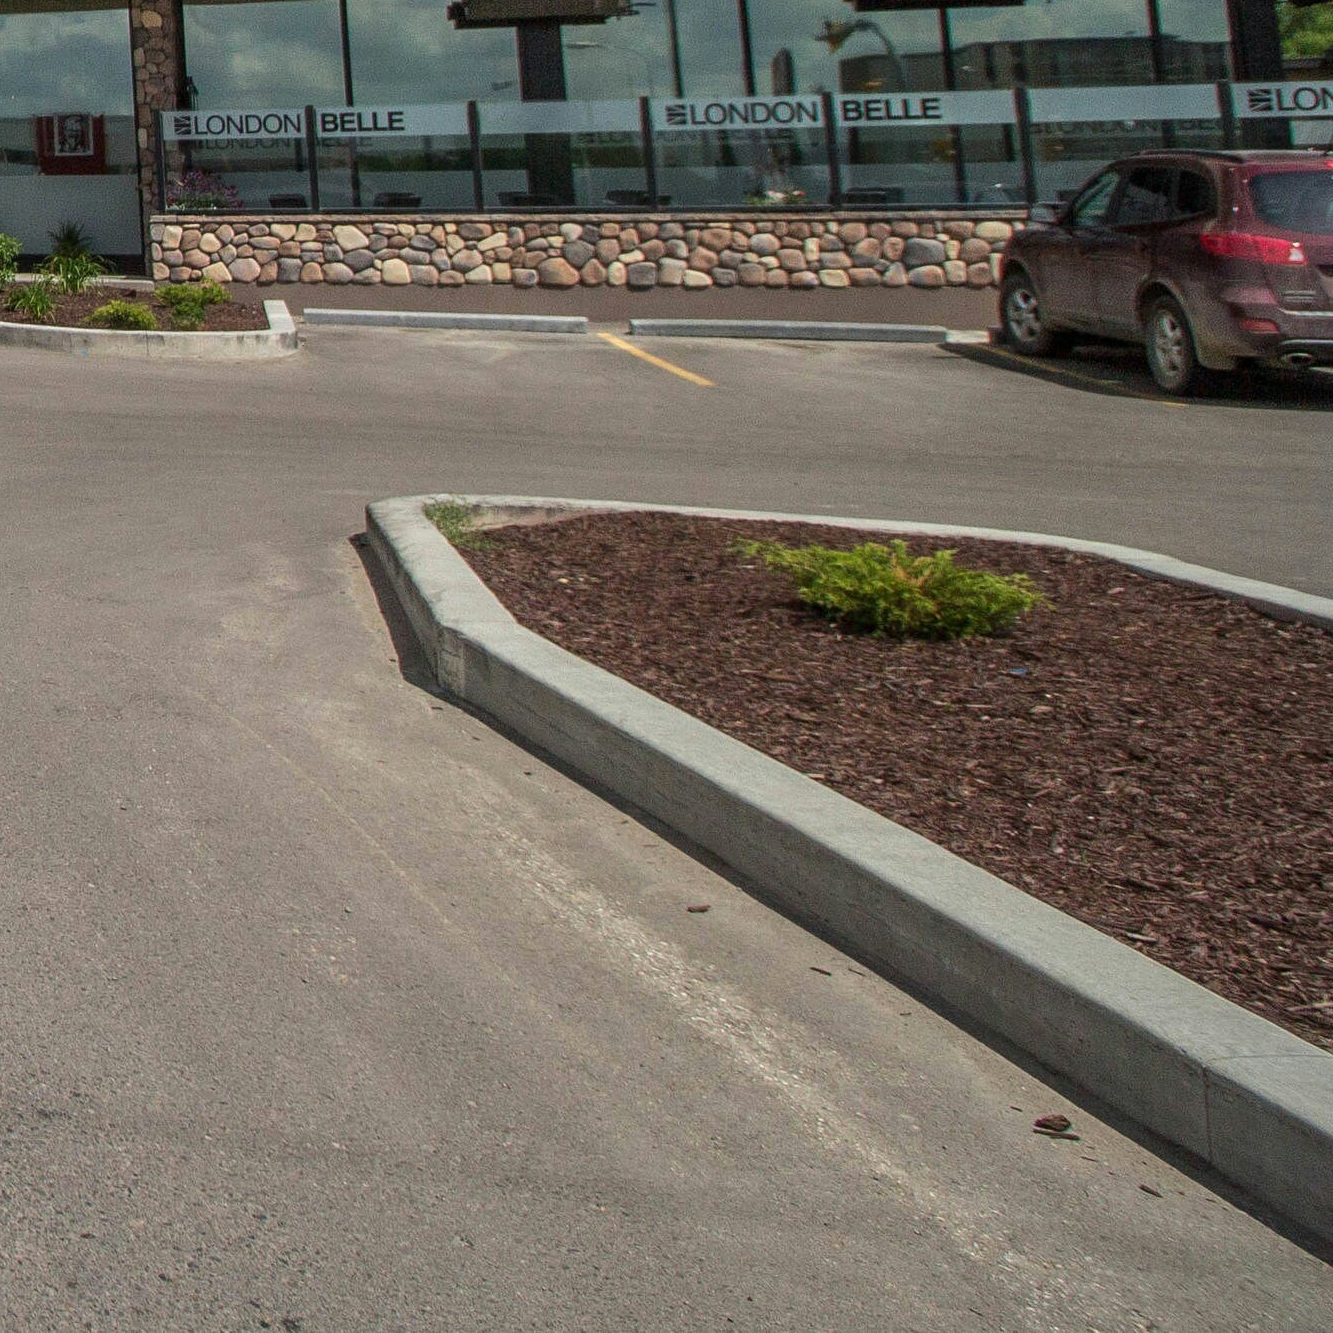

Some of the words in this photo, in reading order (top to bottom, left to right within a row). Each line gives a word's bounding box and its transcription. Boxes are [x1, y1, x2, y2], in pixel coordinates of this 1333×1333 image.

[193, 112, 301, 136] LONDON
[320, 110, 405, 133] BELLE
[689, 100, 818, 126] LONDON
[841, 97, 942, 122] BELLE
